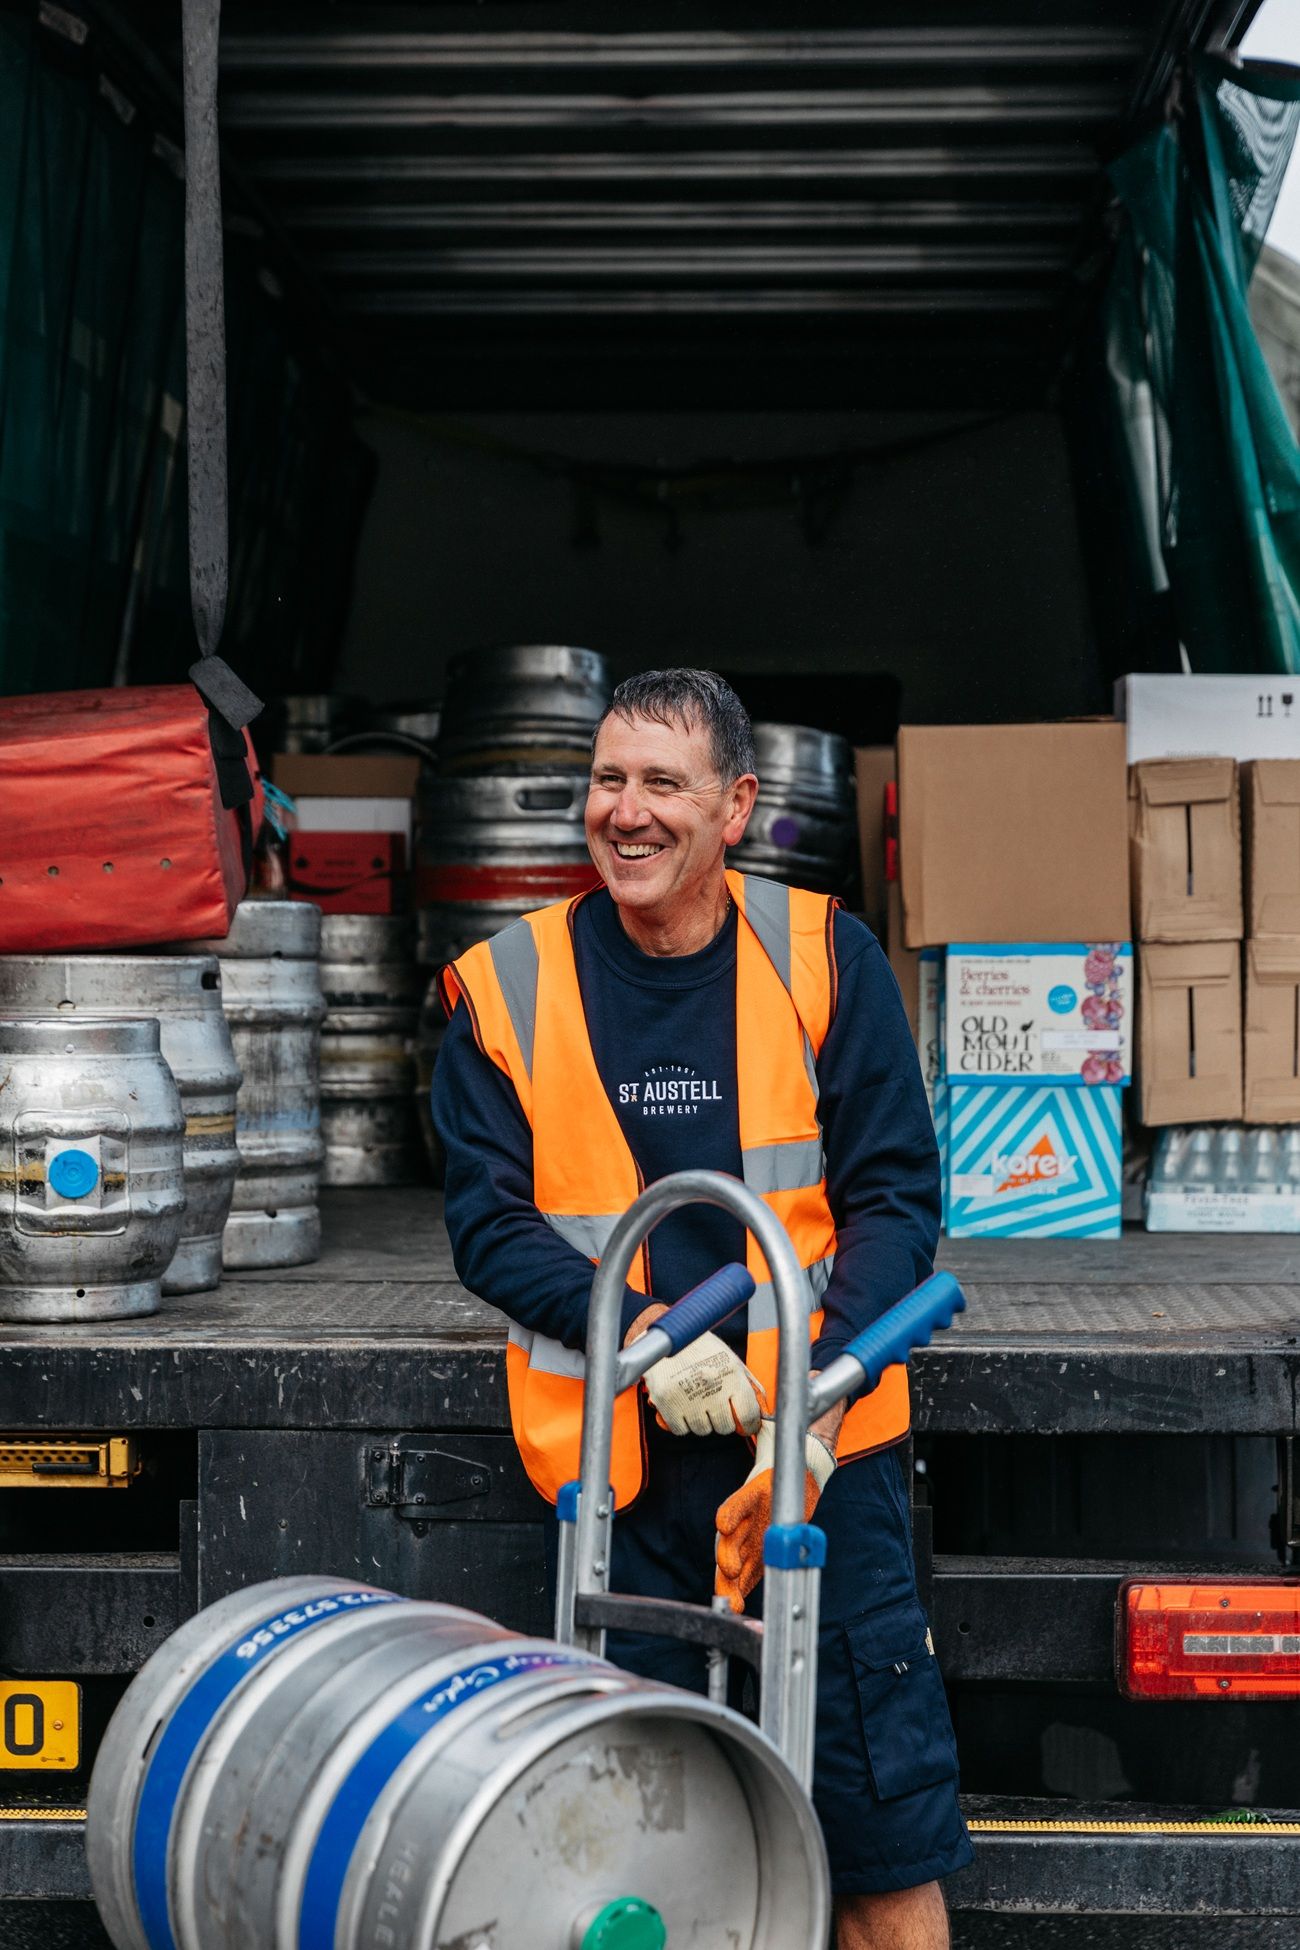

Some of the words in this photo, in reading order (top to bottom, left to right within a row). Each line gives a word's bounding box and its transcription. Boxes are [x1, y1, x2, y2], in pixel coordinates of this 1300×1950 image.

[959, 980, 971, 995] &
[975, 980, 1031, 996] cherries
[961, 1015, 1008, 1033] OLD
[963, 1033, 1030, 1051] MOUT
[960, 1051, 1034, 1072] CIDER
[643, 1080, 722, 1102] AUSTELL
[643, 1105, 698, 1115] BREWERY
[991, 1150, 1080, 1176] korev
